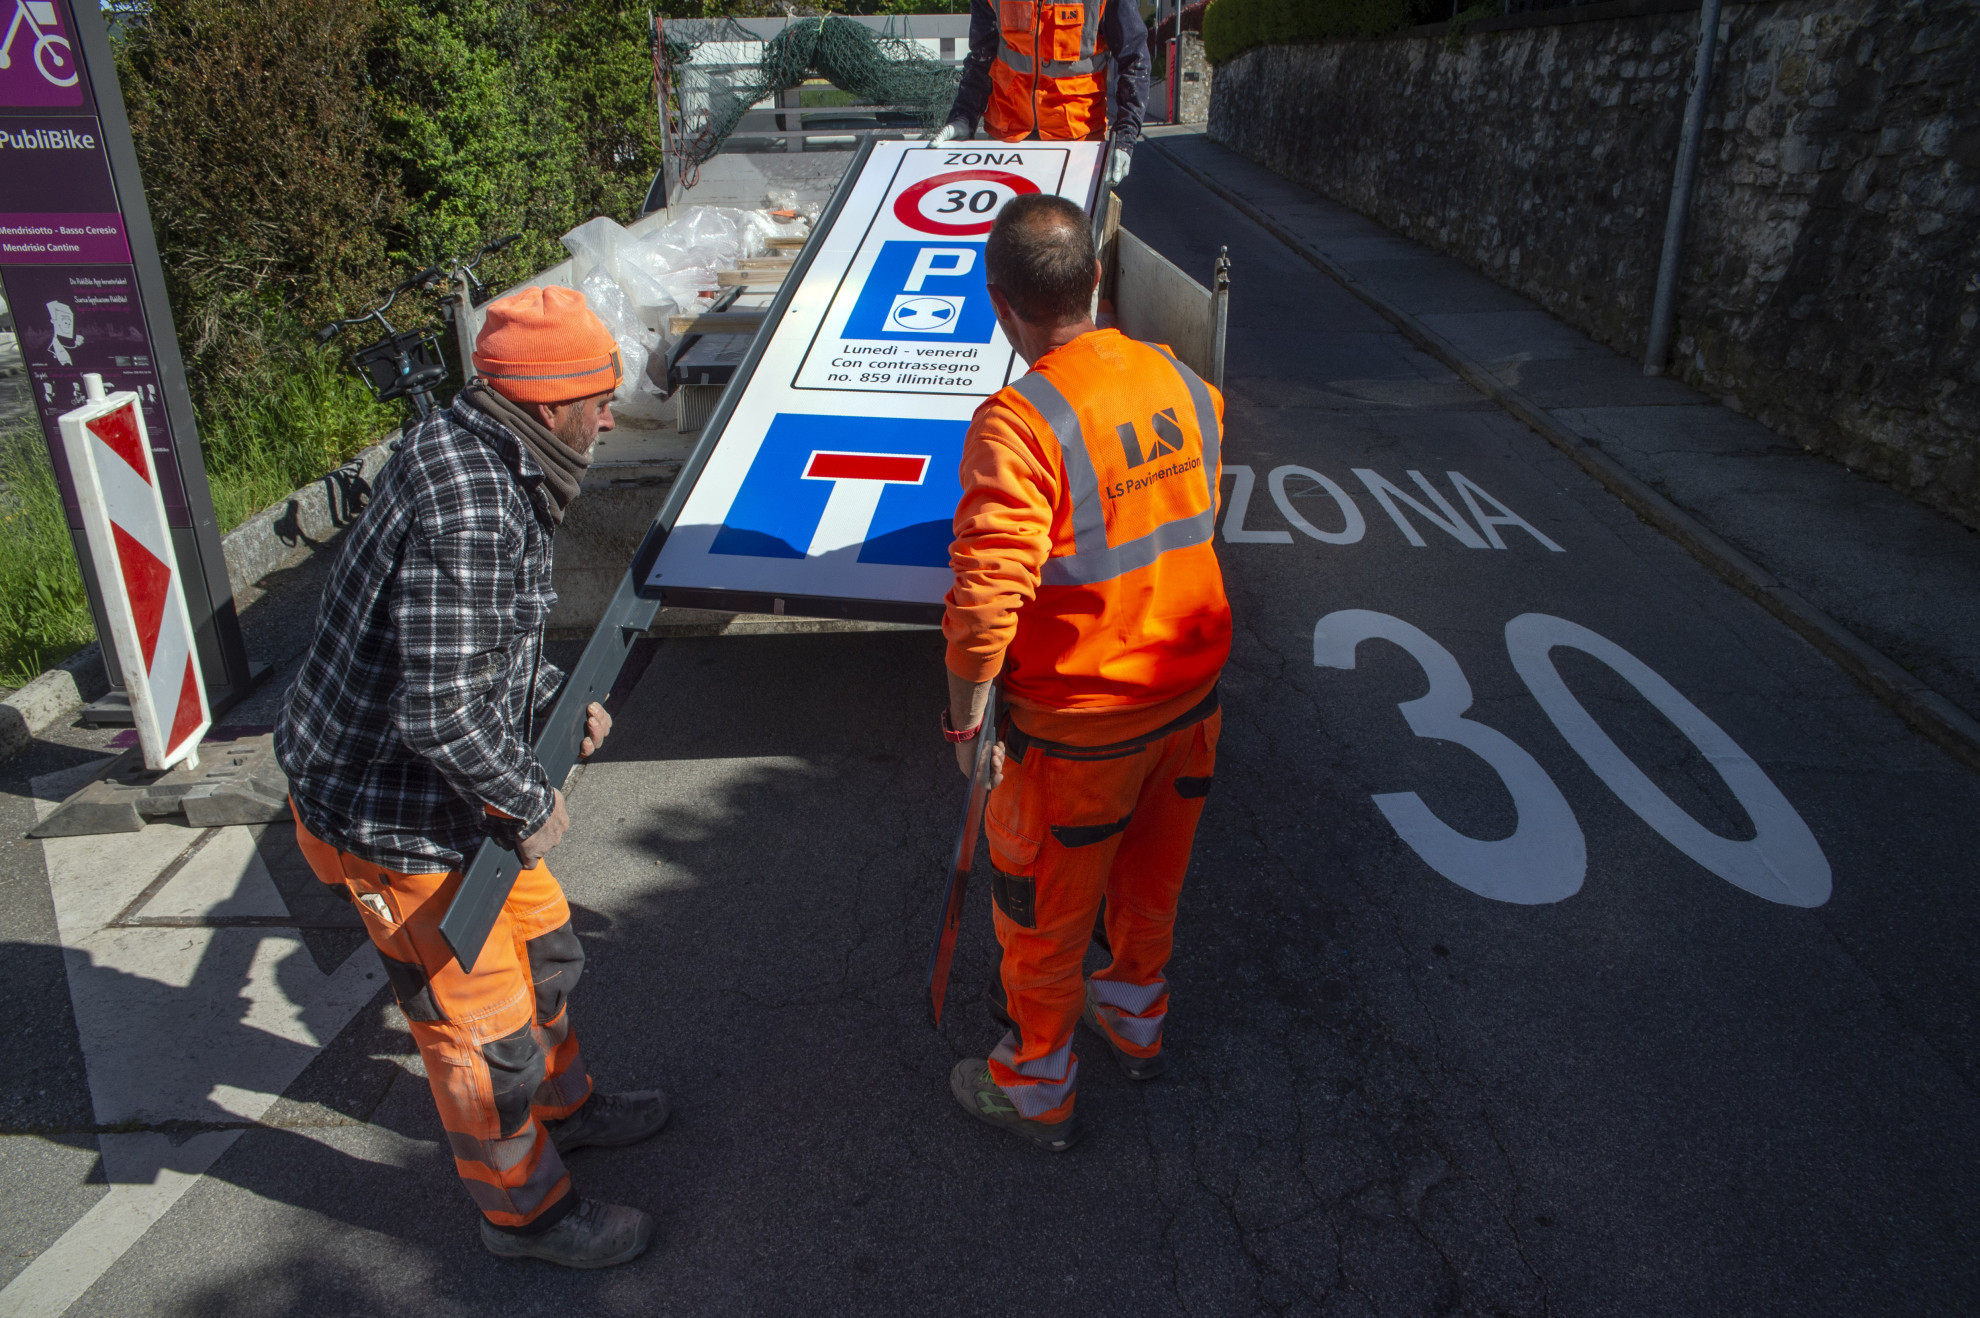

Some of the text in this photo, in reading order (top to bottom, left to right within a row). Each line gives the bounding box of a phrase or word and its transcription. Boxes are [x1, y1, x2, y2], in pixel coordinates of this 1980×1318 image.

[1061, 10, 1078, 20] LS
[0, 129, 95, 149] PubliBike
[943, 153, 1024, 166] ZONA
[936, 189, 998, 214] 30
[0, 226, 53, 235] Mendrisiotto
[60, 226, 84, 235] Basso
[85, 225, 117, 235] Ceresio
[2, 242, 80, 252] Mendrisio Cantine
[902, 247, 977, 292] P
[842, 344, 898, 355] Lunedì
[916, 348, 978, 359] venerdì
[831, 357, 981, 374] Con contrassegno
[827, 373, 973, 386] no. 859 illimitato
[1115, 407, 1185, 469] LS
[1106, 483, 1125, 499] LS
[1221, 464, 1567, 553] ZONA
[1312, 608, 1832, 908] 30
